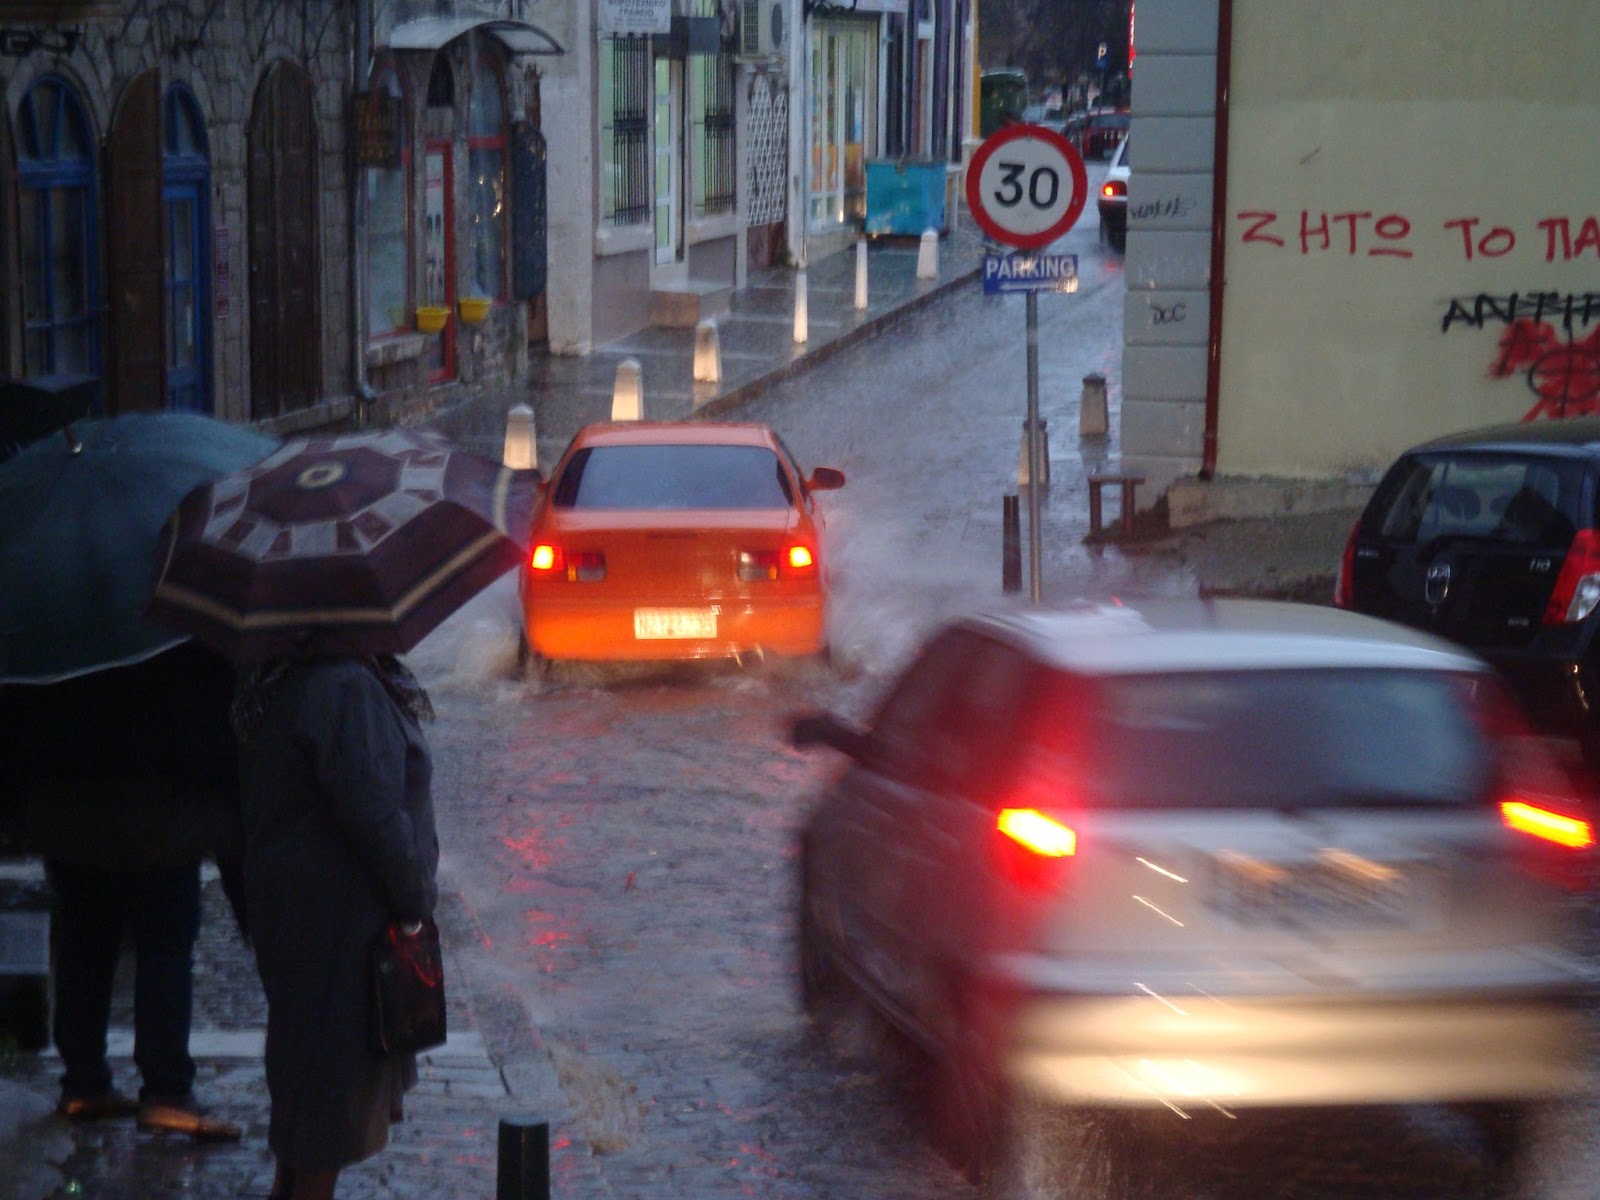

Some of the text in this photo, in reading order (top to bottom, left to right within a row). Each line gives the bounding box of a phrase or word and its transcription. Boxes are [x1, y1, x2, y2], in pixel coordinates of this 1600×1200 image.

[1097, 42, 1107, 60] P
[994, 162, 1060, 210] 30
[1443, 216, 1517, 261] ΤΟ
[986, 257, 1075, 281] PARKING
